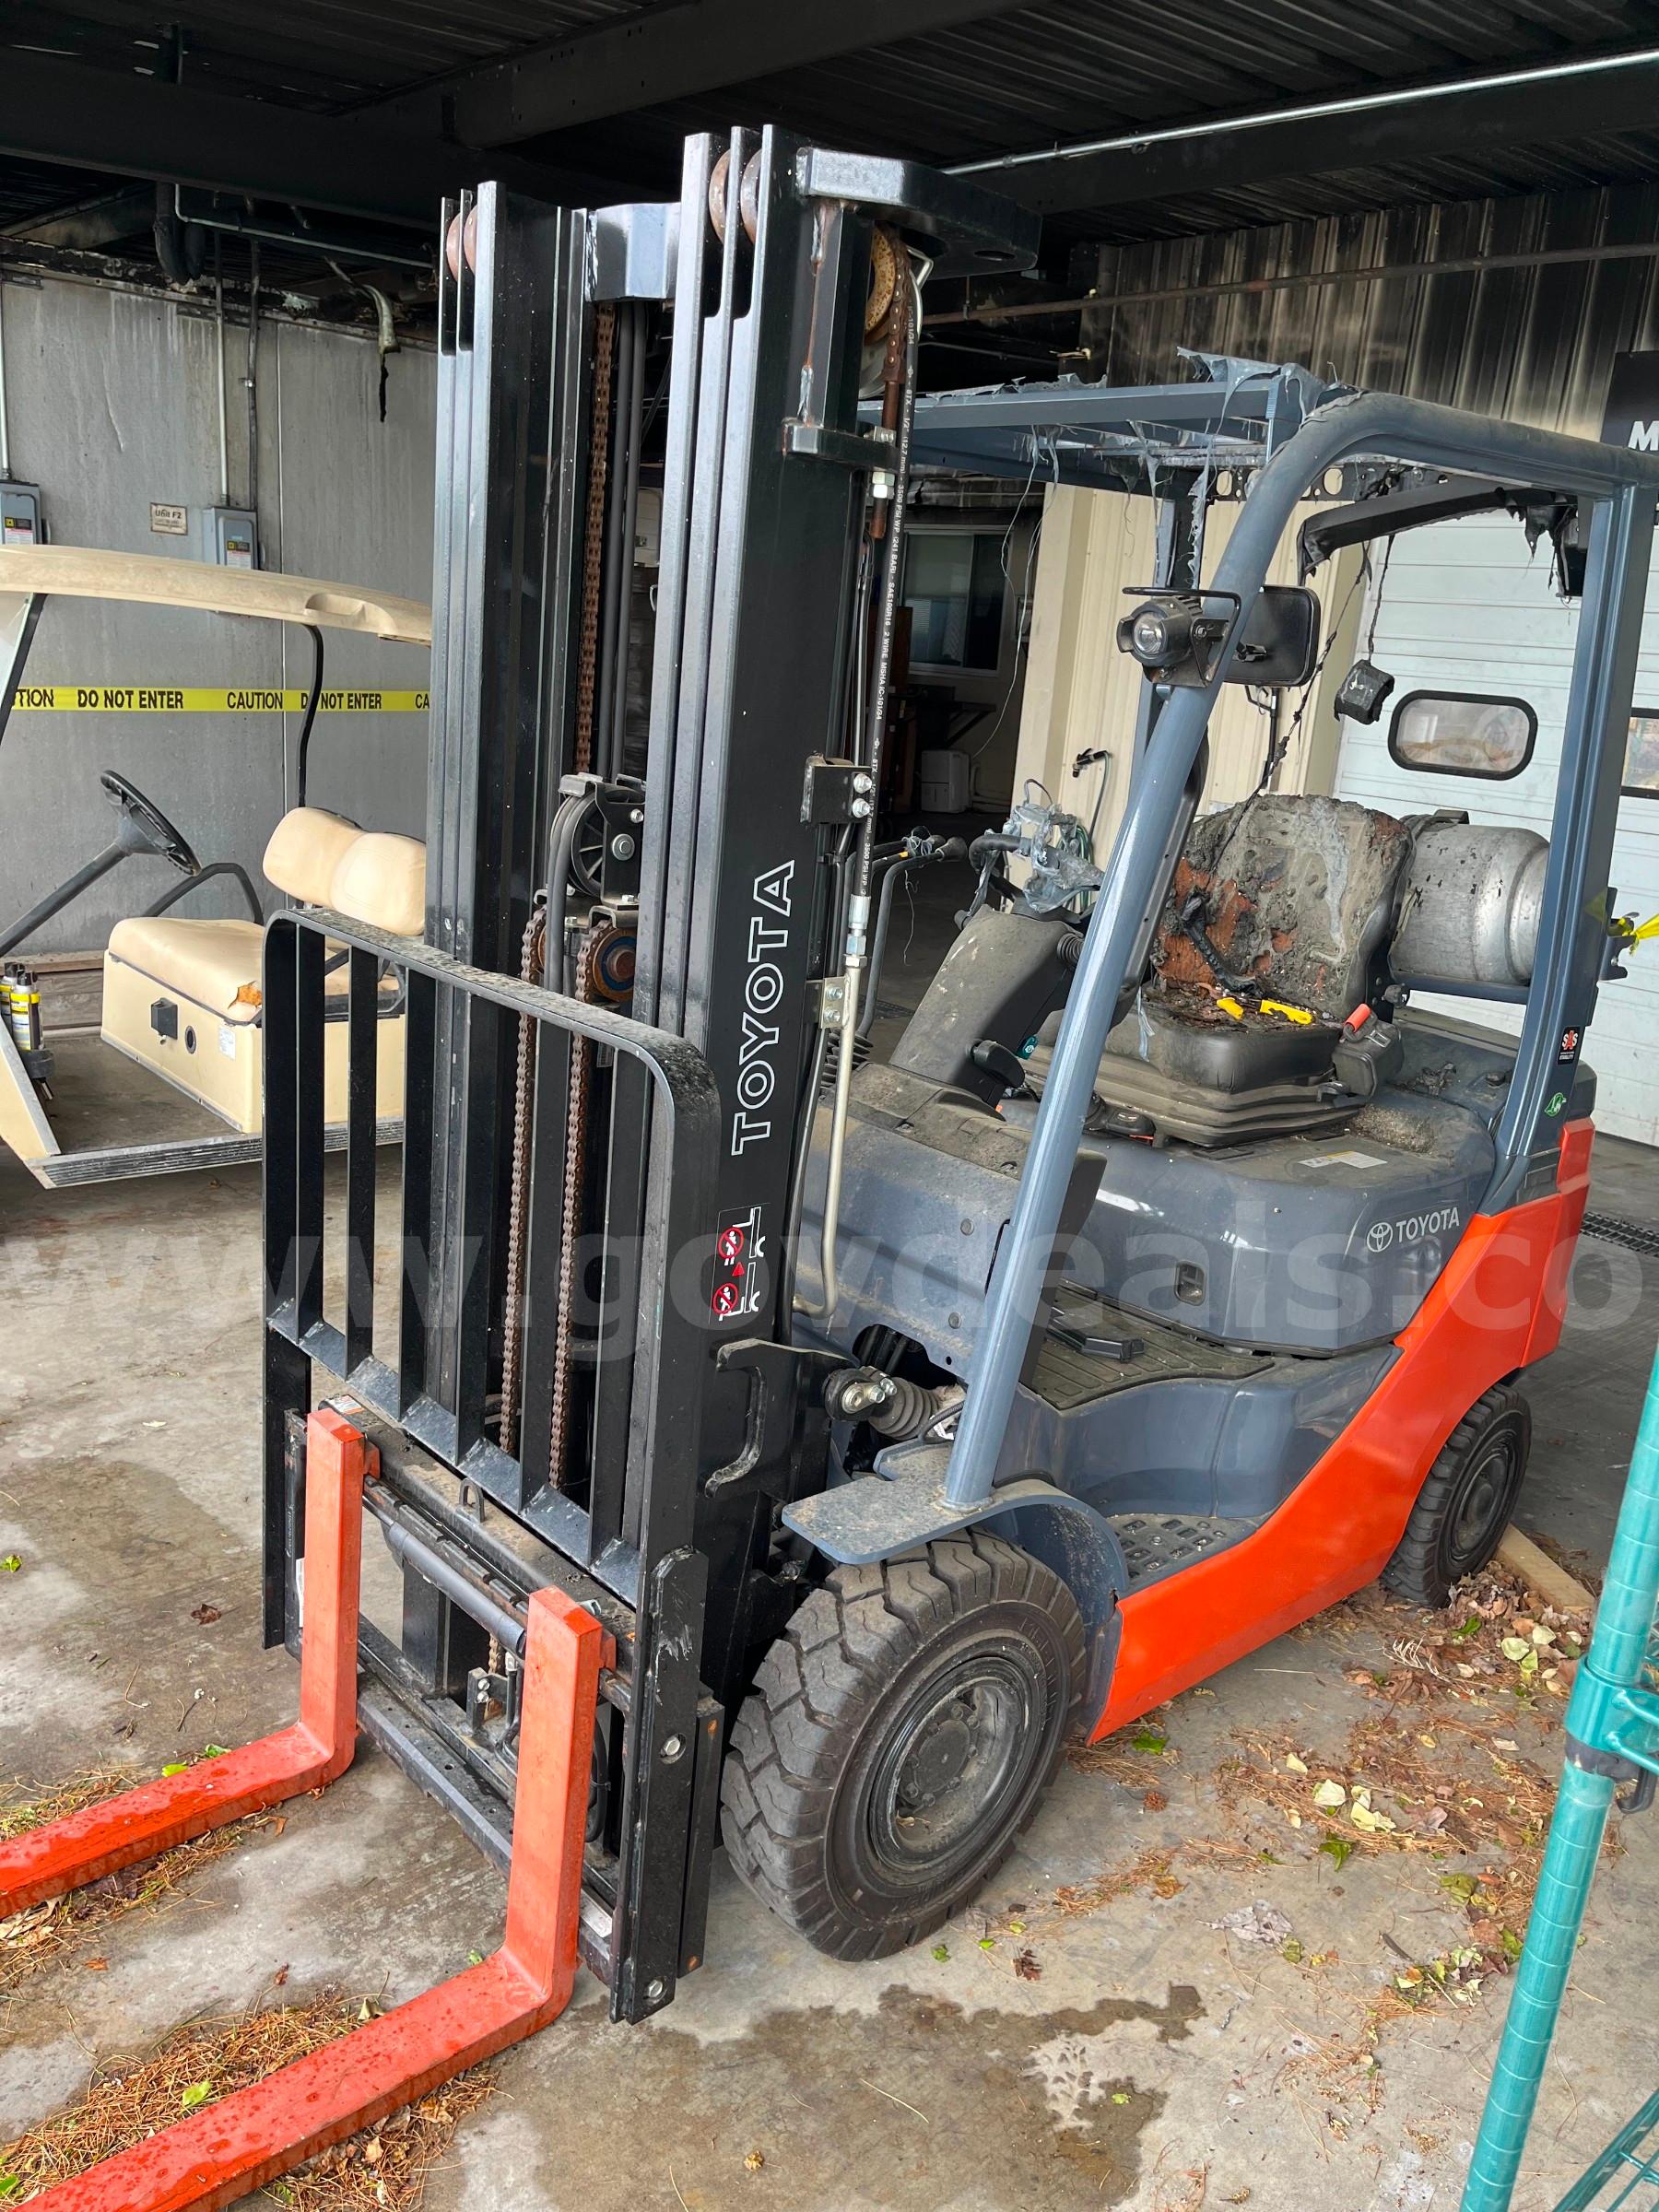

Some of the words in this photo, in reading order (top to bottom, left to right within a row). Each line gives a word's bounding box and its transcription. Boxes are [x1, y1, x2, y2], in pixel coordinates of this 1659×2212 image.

[172, 511, 182, 519] F2
[894, 519, 901, 533] WP
[885, 582, 895, 626] SAE100R16
[881, 638, 890, 659] WIRE
[879, 662, 888, 685] MSHA
[13, 688, 54, 708] TION
[77, 689, 100, 708] DO
[103, 689, 134, 709] NOT
[139, 690, 184, 709] ENTER
[227, 691, 283, 710] CAUTION
[321, 693, 344, 710] NOT
[347, 693, 382, 710] ENTER
[862, 874, 868, 886] WP
[731, 859, 795, 1157] TOYOTA
[1561, 1030, 1579, 1051] SAS
[1395, 1206, 1460, 1243] TOYOTA
